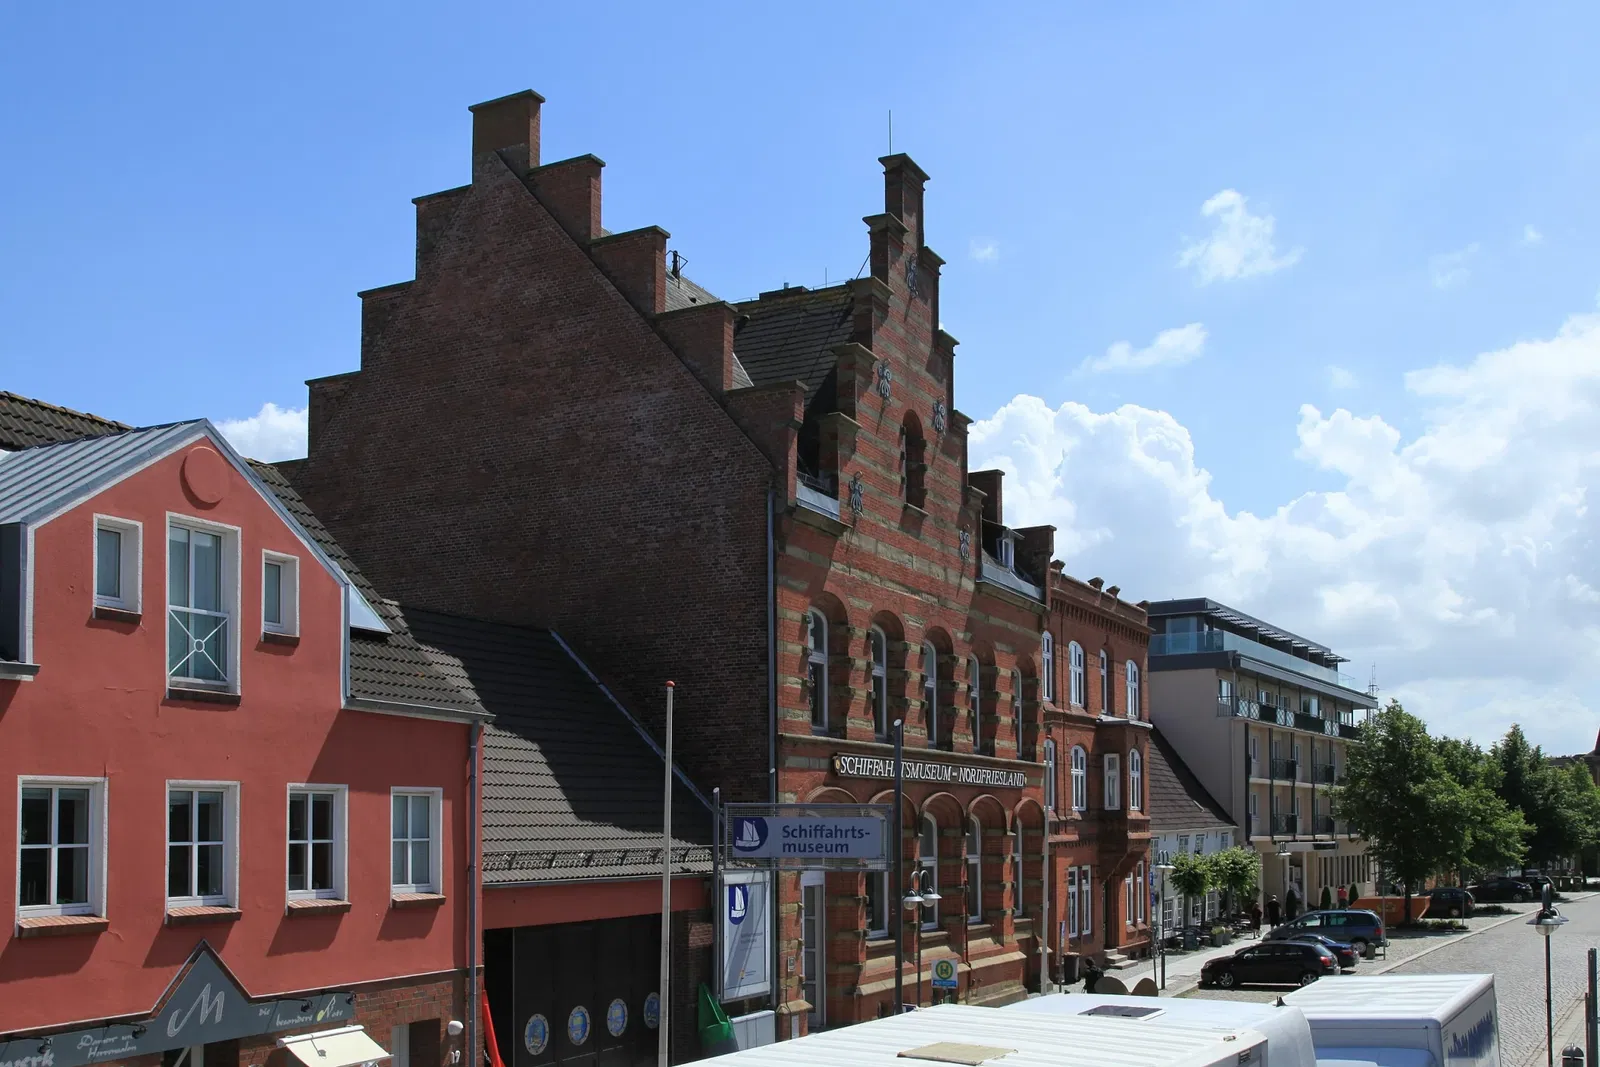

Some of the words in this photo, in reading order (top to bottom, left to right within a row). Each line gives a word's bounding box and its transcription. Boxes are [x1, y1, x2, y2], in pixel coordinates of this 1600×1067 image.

[781, 823, 870, 840] Schiffahrts-
[781, 842, 850, 854] museum
[450, 1049, 461, 1064] 19
